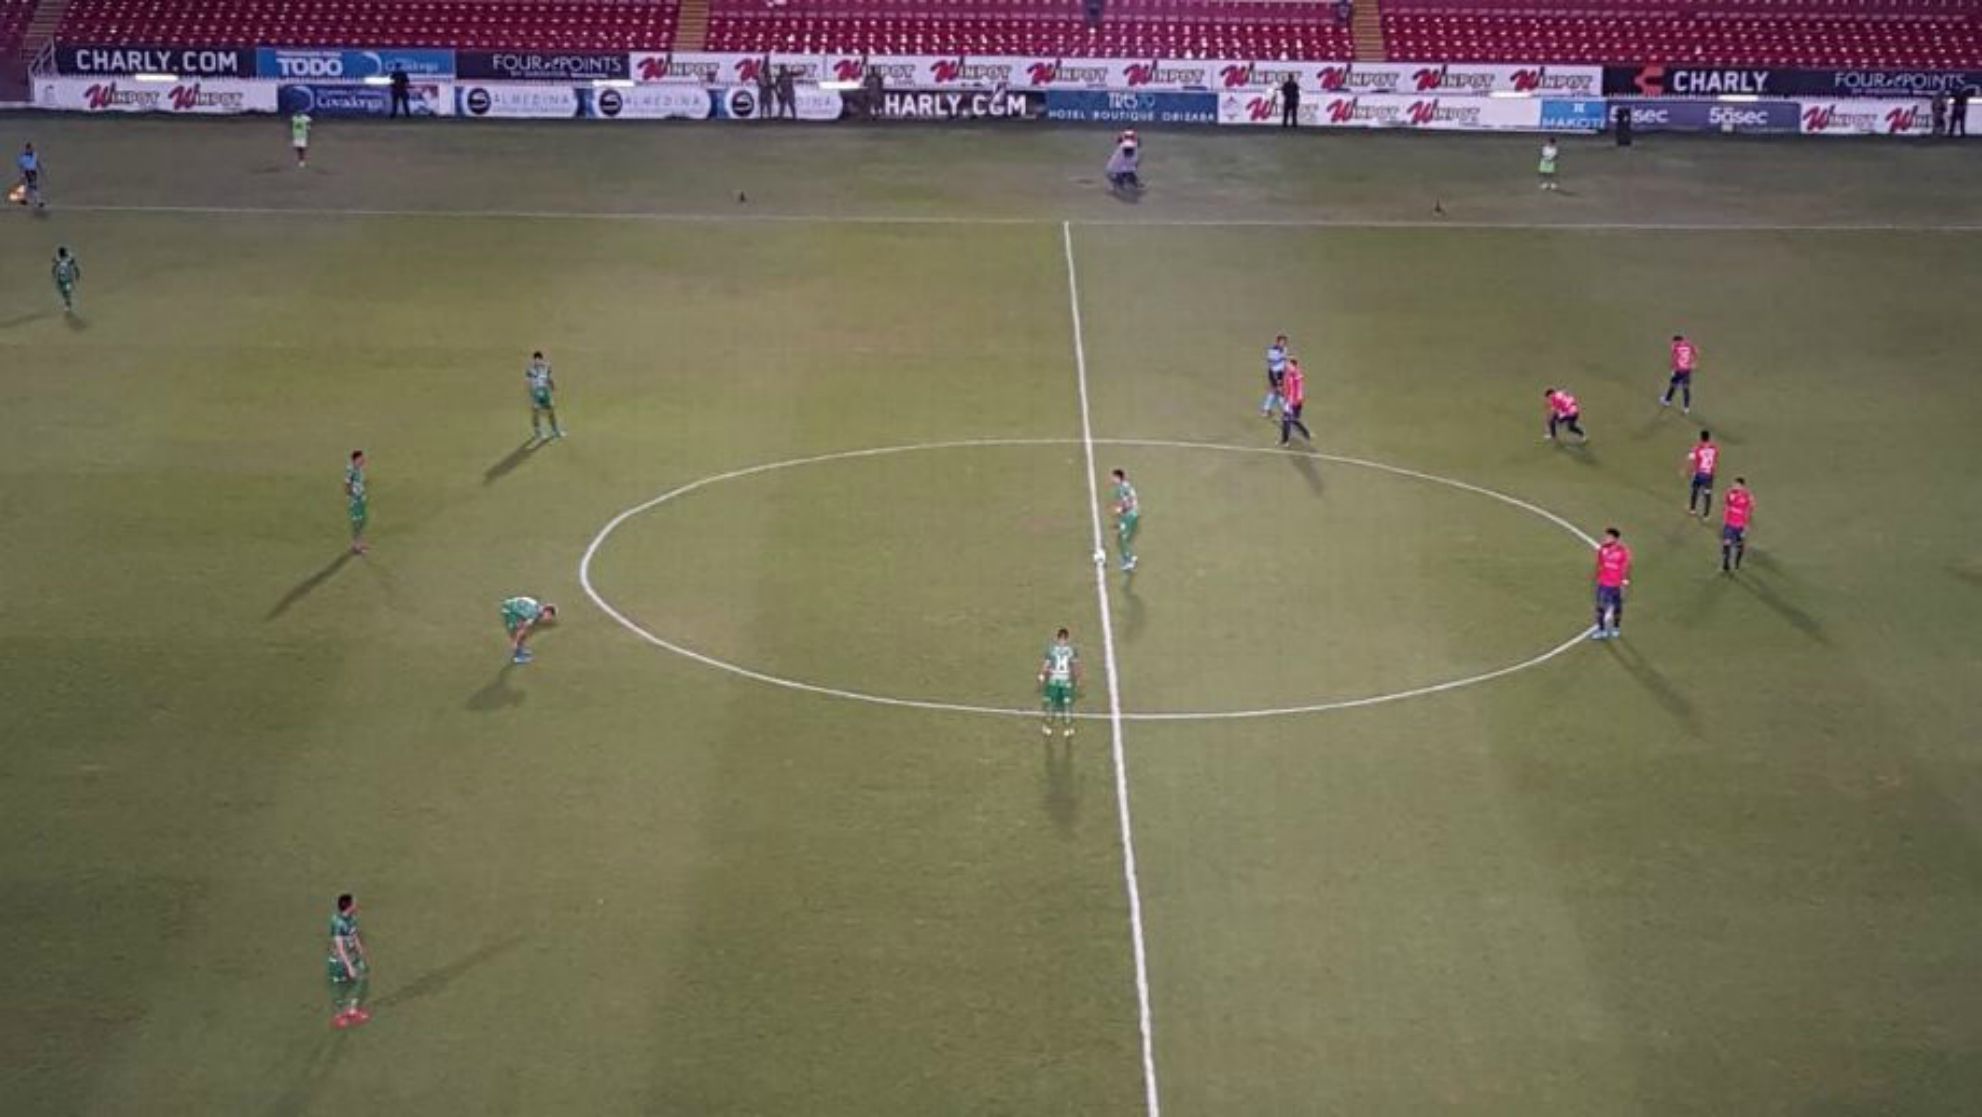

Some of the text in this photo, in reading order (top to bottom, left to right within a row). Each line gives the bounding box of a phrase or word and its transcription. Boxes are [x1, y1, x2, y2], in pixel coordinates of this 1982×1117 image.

[76, 49, 238, 71] CHARLY.COM
[275, 58, 343, 76] TODO
[493, 54, 621, 72] FOUR POINTS
[930, 56, 1012, 83] WINPOT
[1027, 58, 1108, 85] WINPOT
[1123, 60, 1204, 86] WINPOT
[1316, 62, 1400, 89] WINPOT
[1412, 63, 1495, 90] WINPOT
[1510, 65, 1593, 91] WINPOT
[1673, 70, 1768, 91] CHARLY
[1835, 72, 1886, 87] FOUR
[870, 93, 1027, 117] HARLY.COM
[1048, 109, 1086, 119] HOTEL
